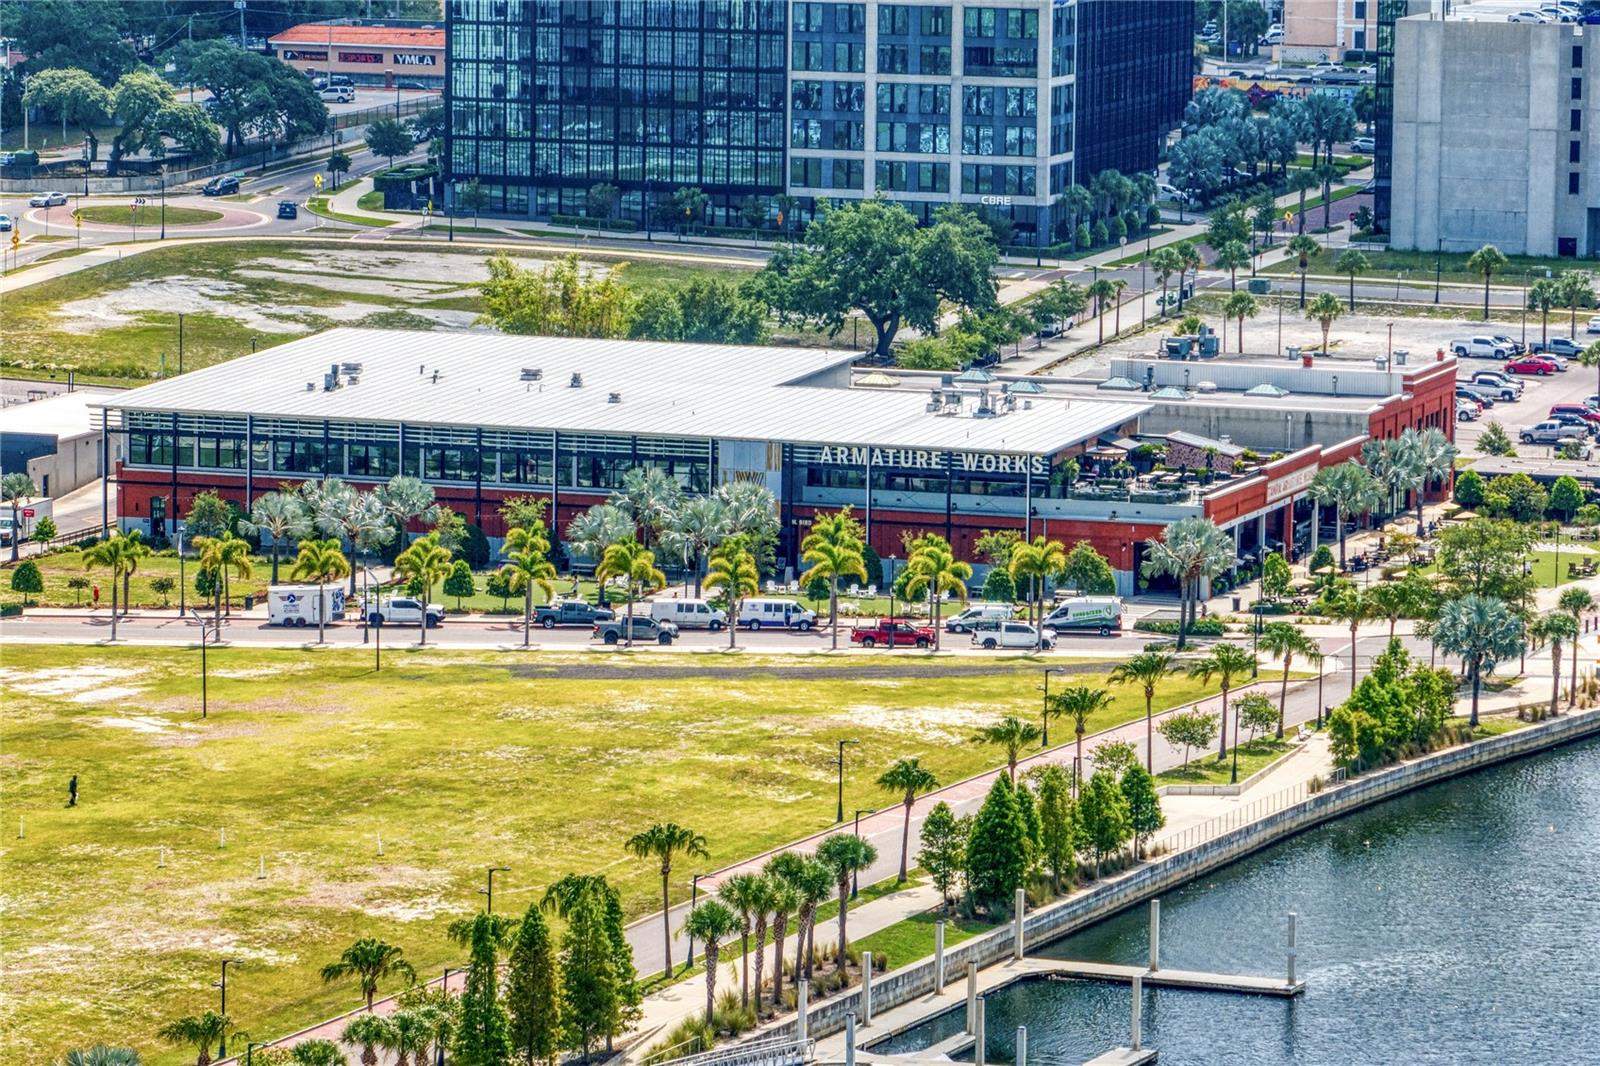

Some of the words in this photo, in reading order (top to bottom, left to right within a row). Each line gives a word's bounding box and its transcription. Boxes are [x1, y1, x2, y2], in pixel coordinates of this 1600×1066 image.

[396, 54, 433, 65] YMCA
[981, 195, 1011, 205] CBRE
[820, 445, 943, 469] ARMATURE
[961, 453, 1044, 474] WORKS
